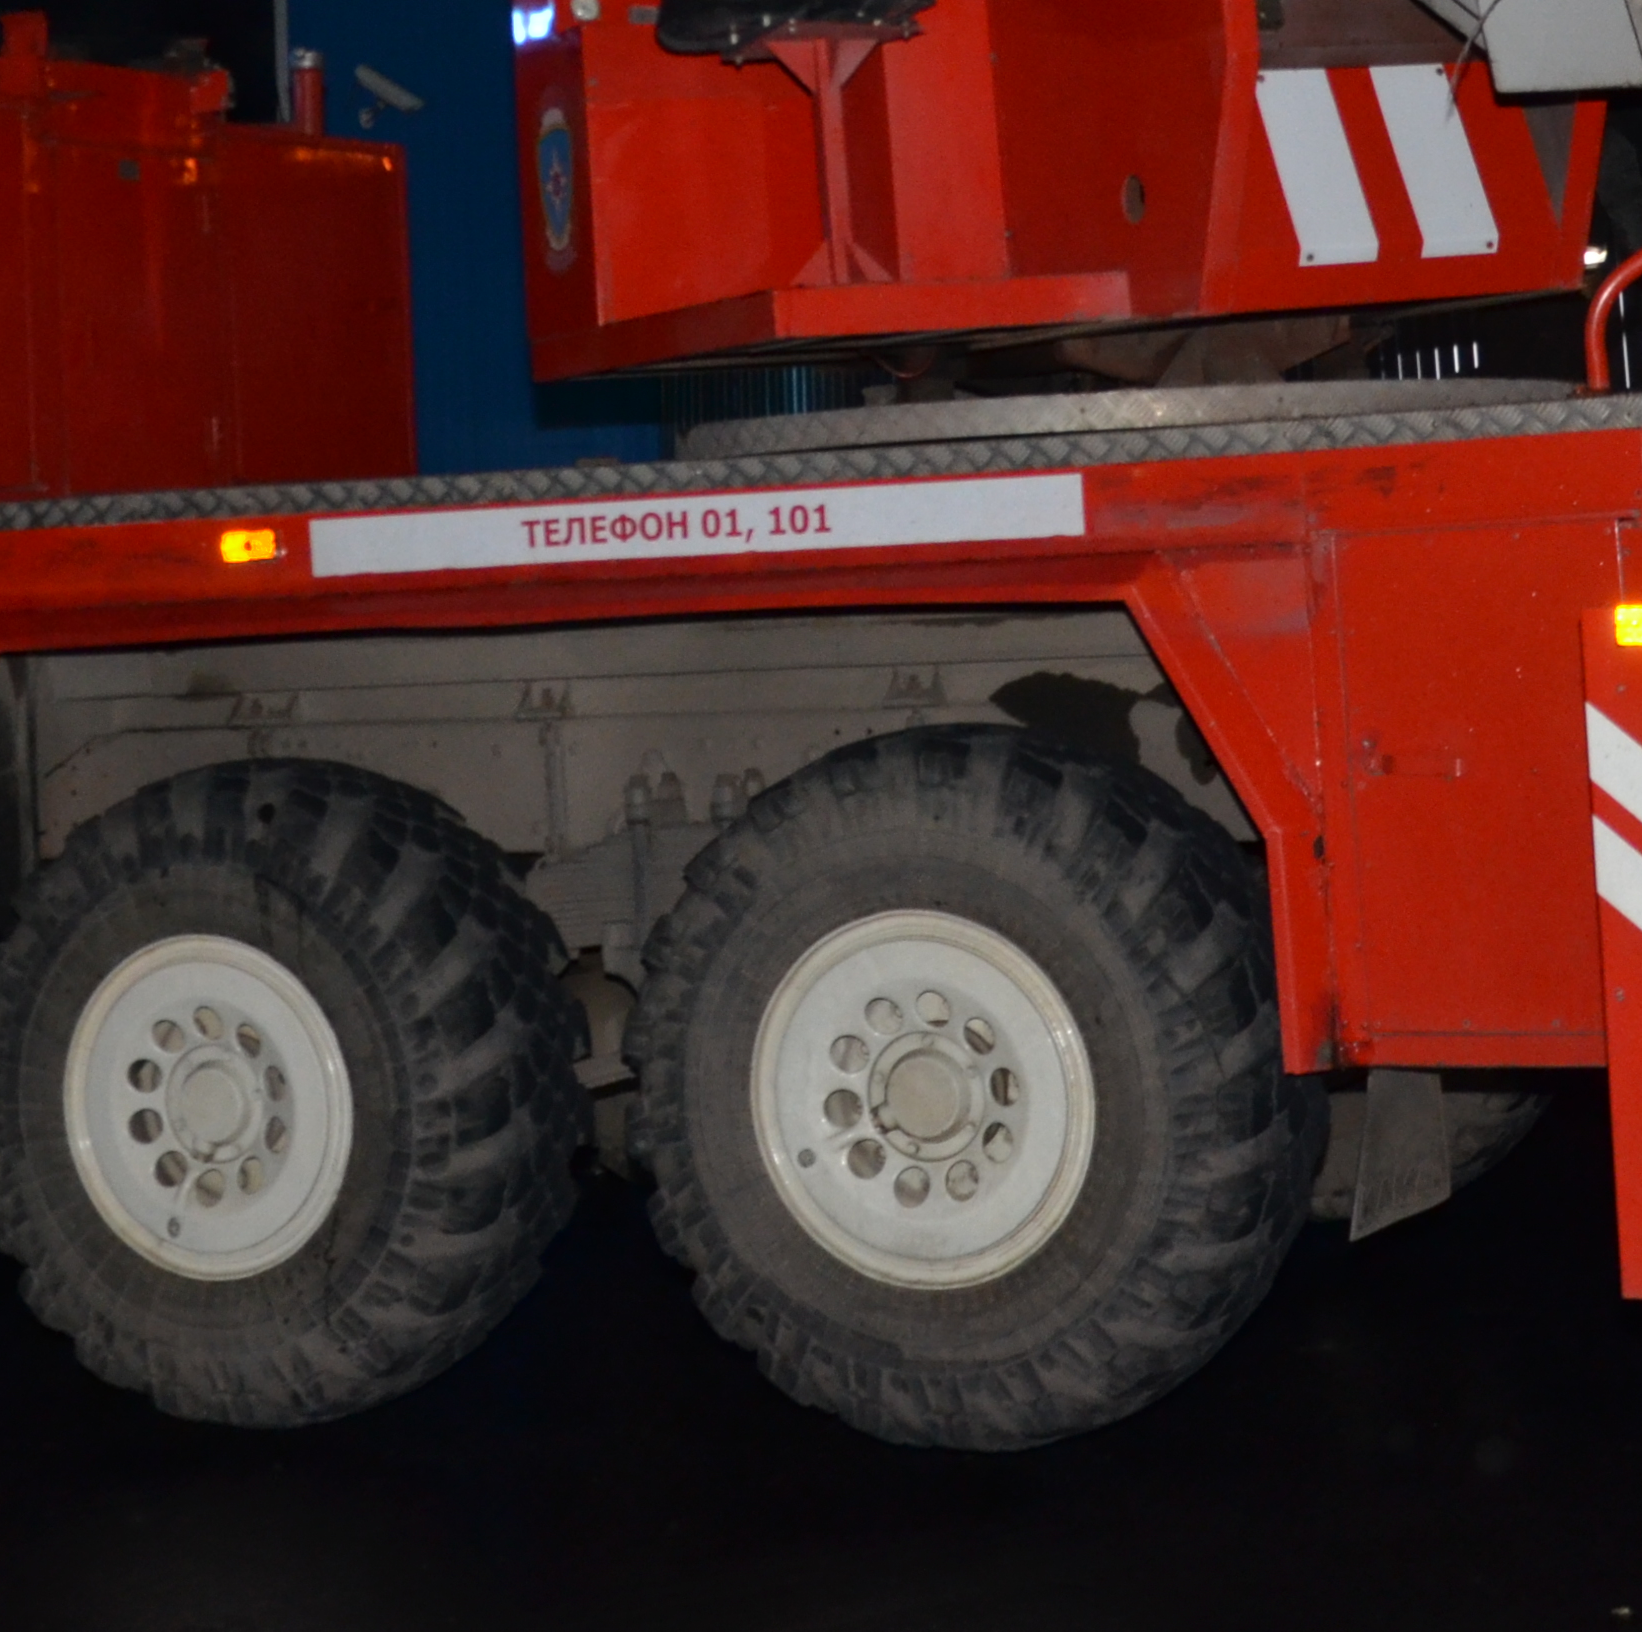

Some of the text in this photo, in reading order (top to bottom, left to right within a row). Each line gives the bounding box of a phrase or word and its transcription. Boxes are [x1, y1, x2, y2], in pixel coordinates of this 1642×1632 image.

[521, 504, 832, 548] ТЕЛЕФОН 01, 101
